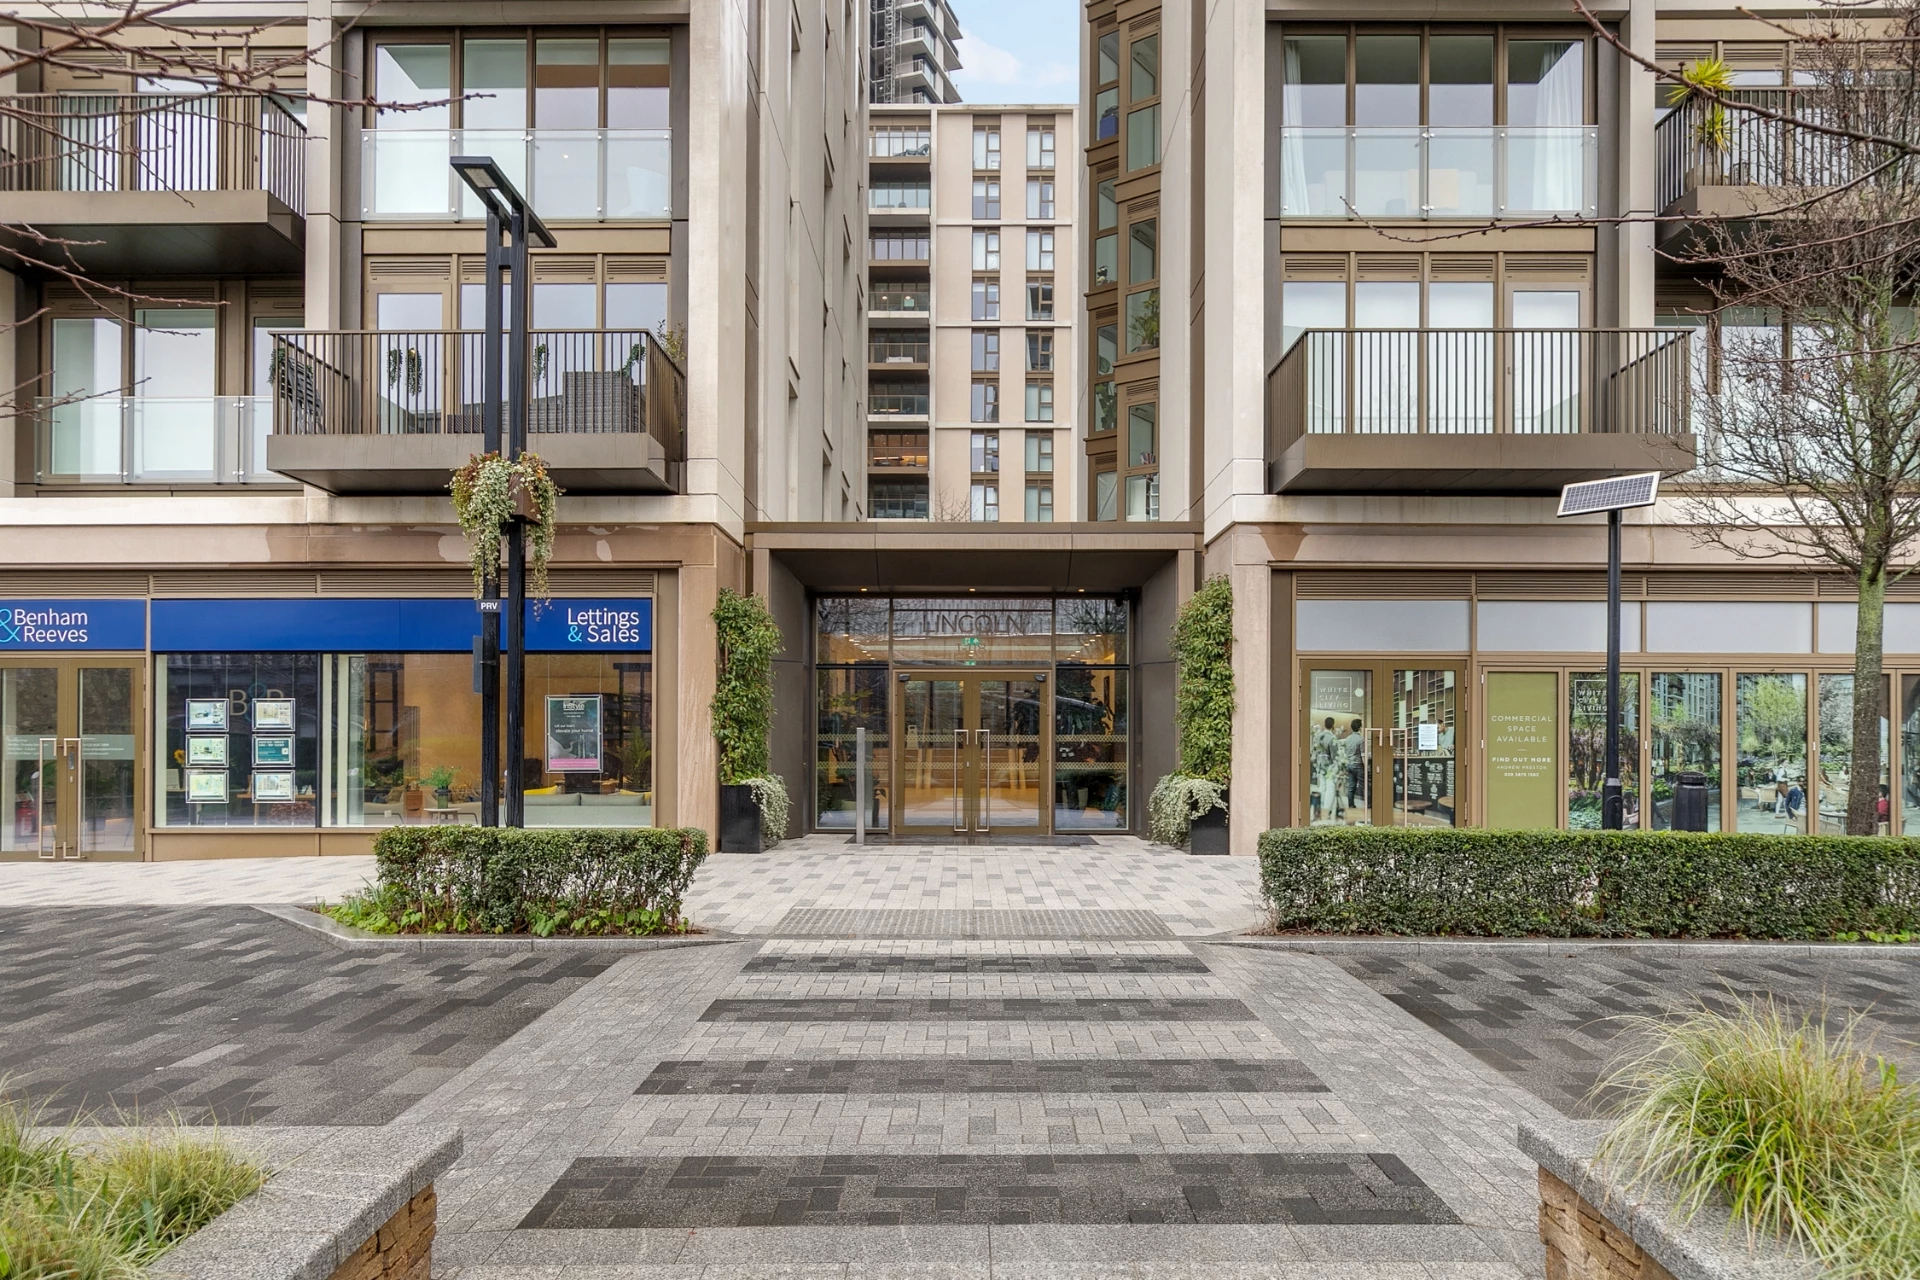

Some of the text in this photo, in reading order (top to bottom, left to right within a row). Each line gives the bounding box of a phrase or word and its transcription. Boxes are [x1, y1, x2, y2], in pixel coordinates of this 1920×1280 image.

[480, 602, 498, 610] PRV
[14, 608, 88, 626] Benham
[567, 607, 640, 629] Lettings
[923, 614, 1025, 633] LINCOLN
[24, 626, 88, 643] Reeves
[567, 625, 640, 643] & Sales
[1496, 735, 1548, 743] AVAILABLE
